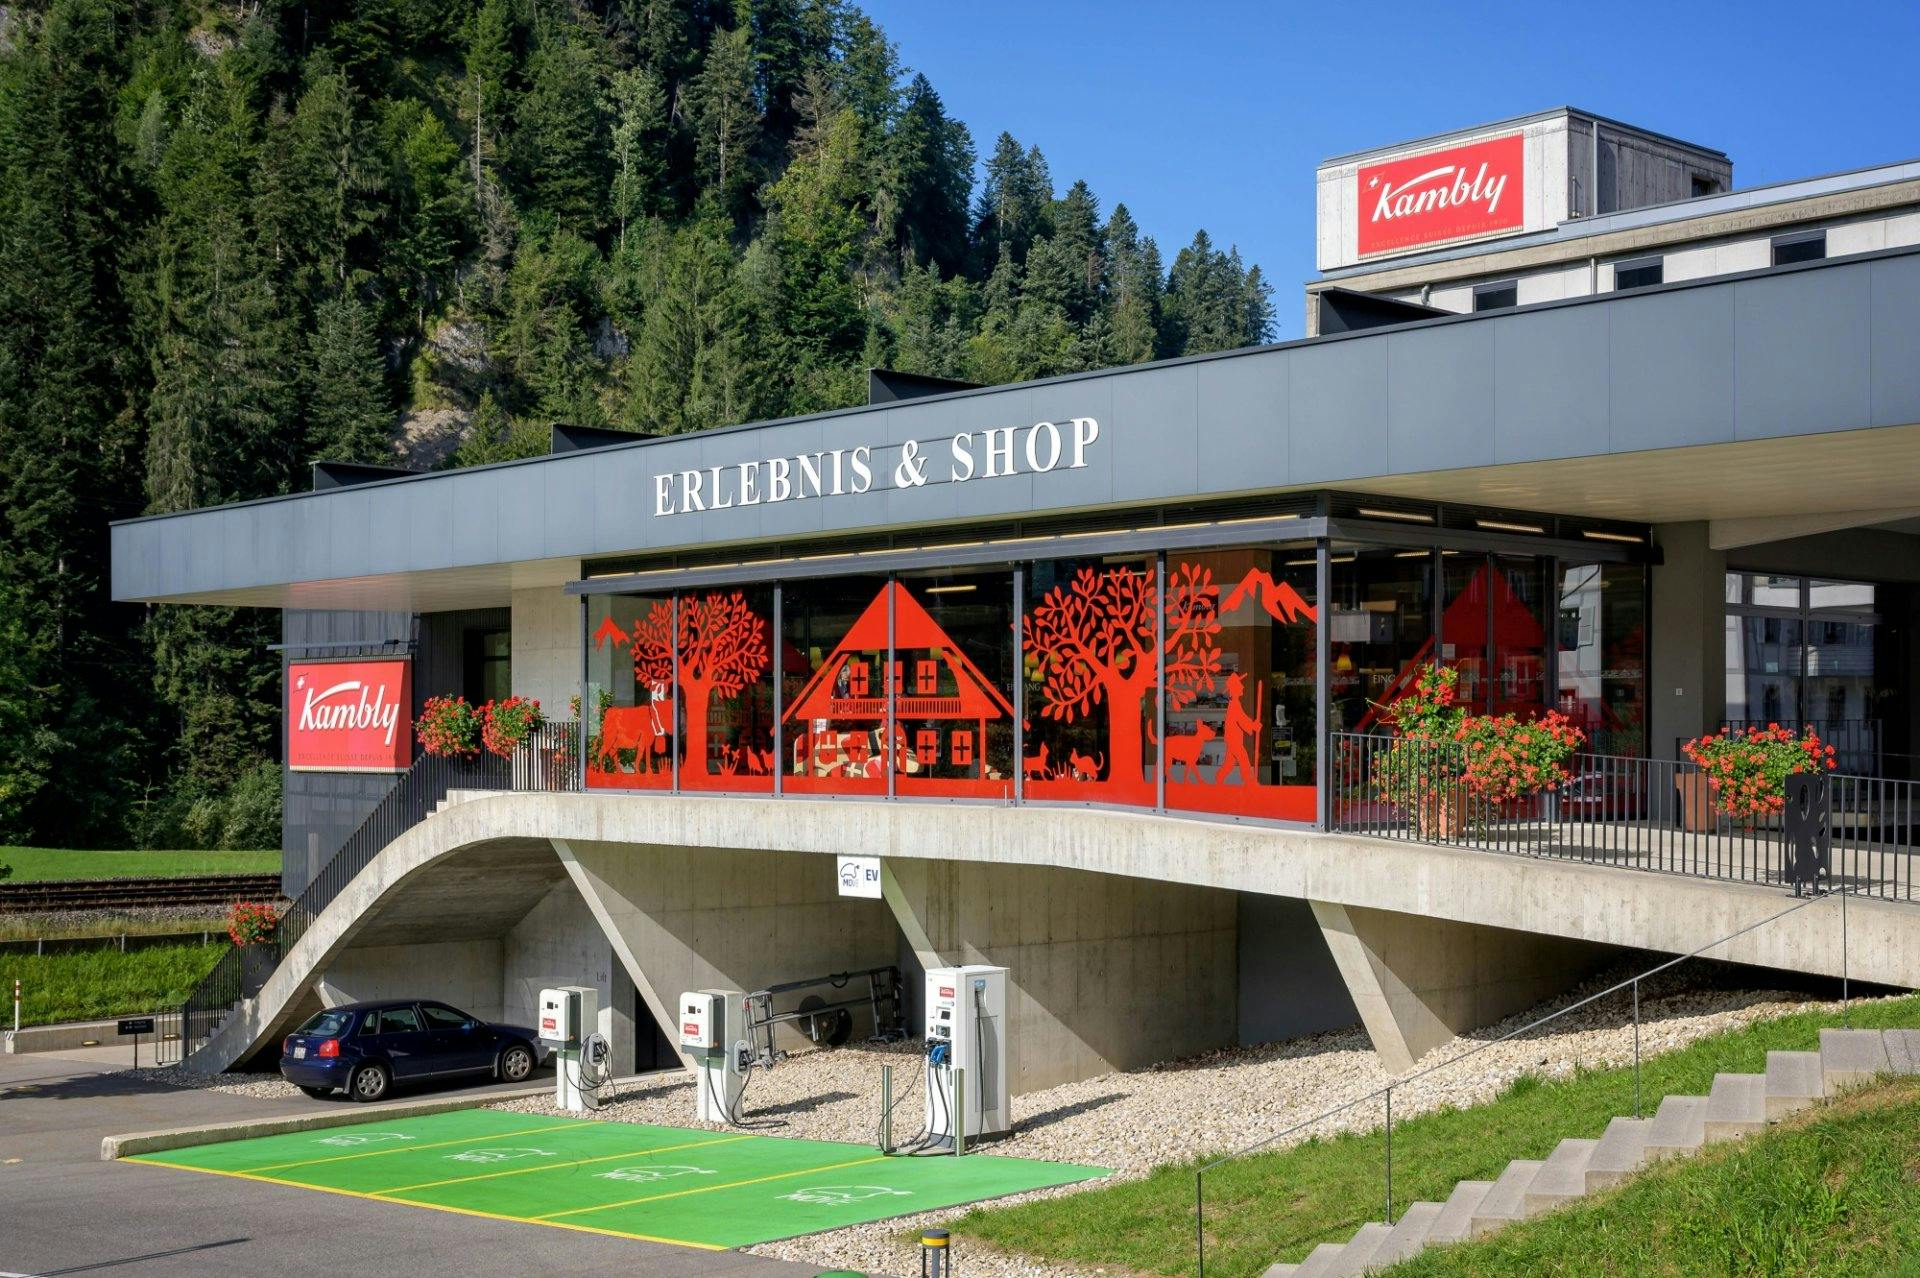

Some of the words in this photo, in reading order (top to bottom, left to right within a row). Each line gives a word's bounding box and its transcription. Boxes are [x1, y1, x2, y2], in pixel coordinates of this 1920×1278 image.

[1371, 162, 1508, 222] Kambly
[653, 446, 873, 517] ERLEBNIS
[895, 439, 928, 489] &
[950, 417, 1100, 483] SHOP
[298, 680, 400, 745] Kambly
[866, 868, 879, 882] EV
